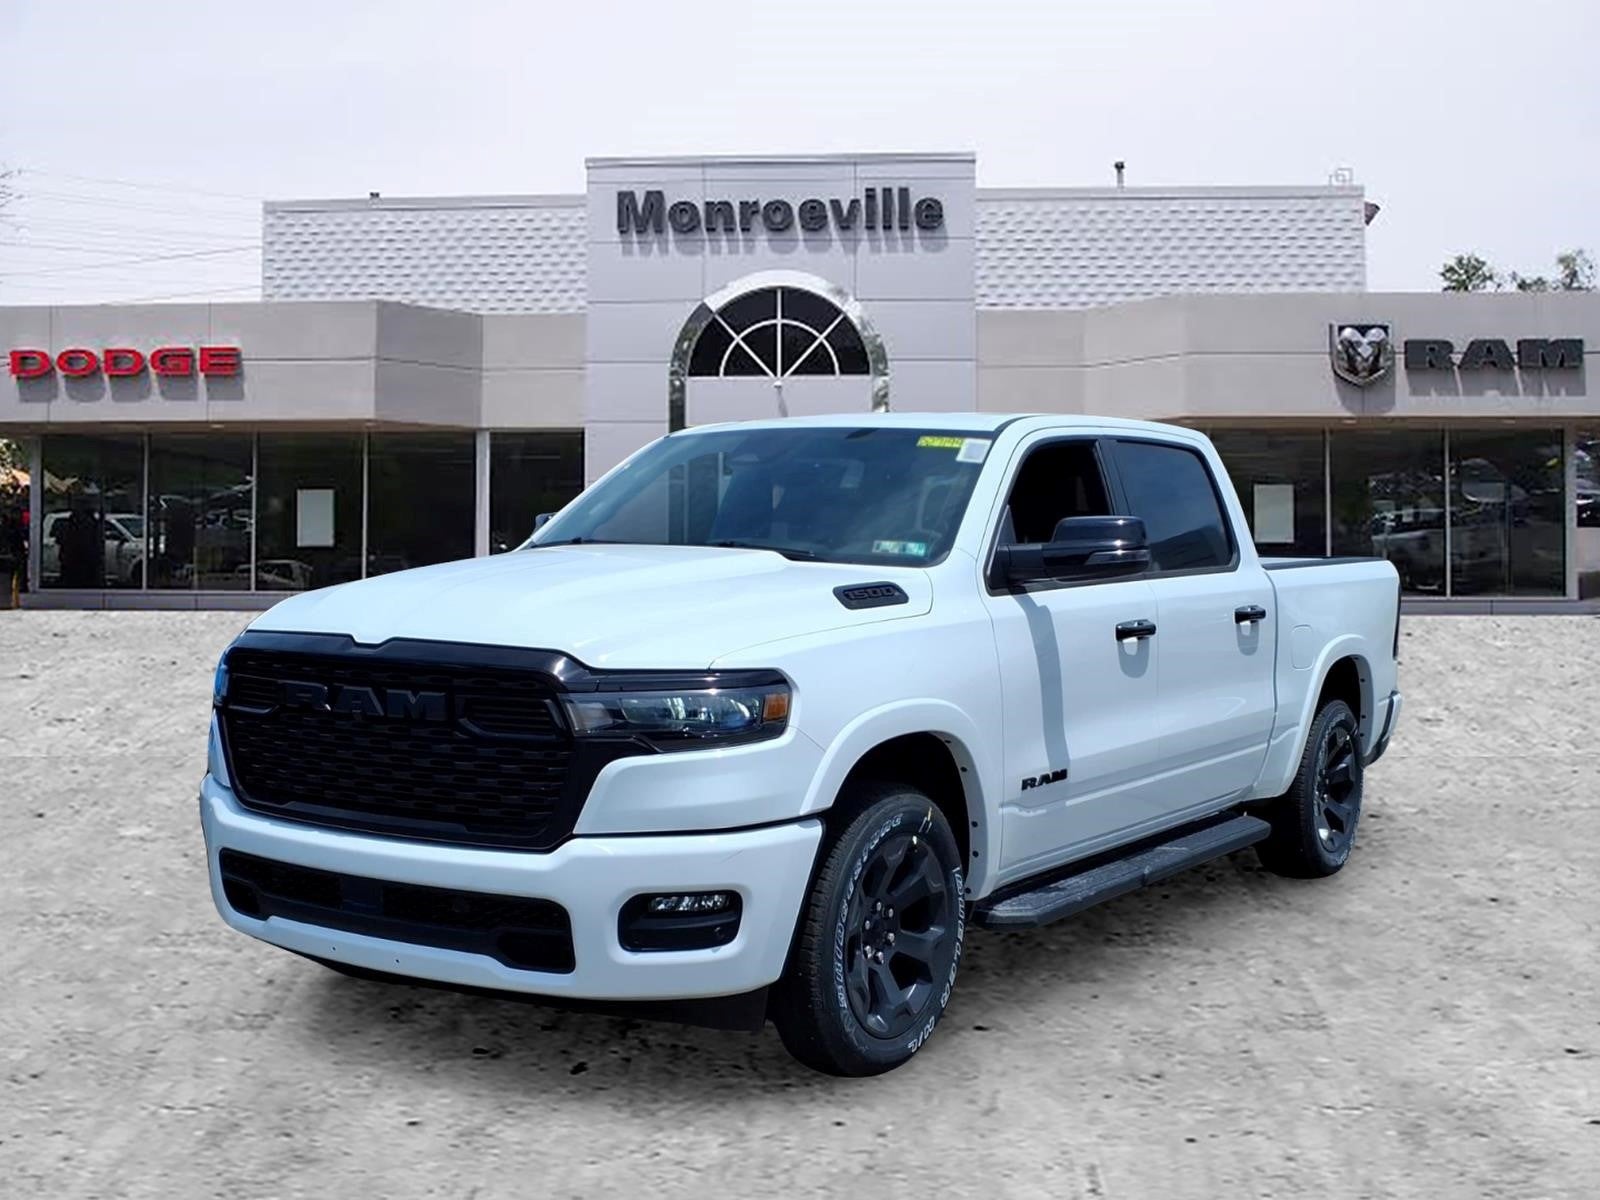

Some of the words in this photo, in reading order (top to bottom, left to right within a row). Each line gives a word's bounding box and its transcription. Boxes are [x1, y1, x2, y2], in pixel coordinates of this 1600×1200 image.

[616, 187, 945, 234] Monroeville
[9, 346, 242, 376] DODGE
[1404, 339, 1584, 369] RAM
[844, 586, 897, 600] 1500
[281, 680, 448, 721] RAM
[1021, 768, 1067, 791] RAM
